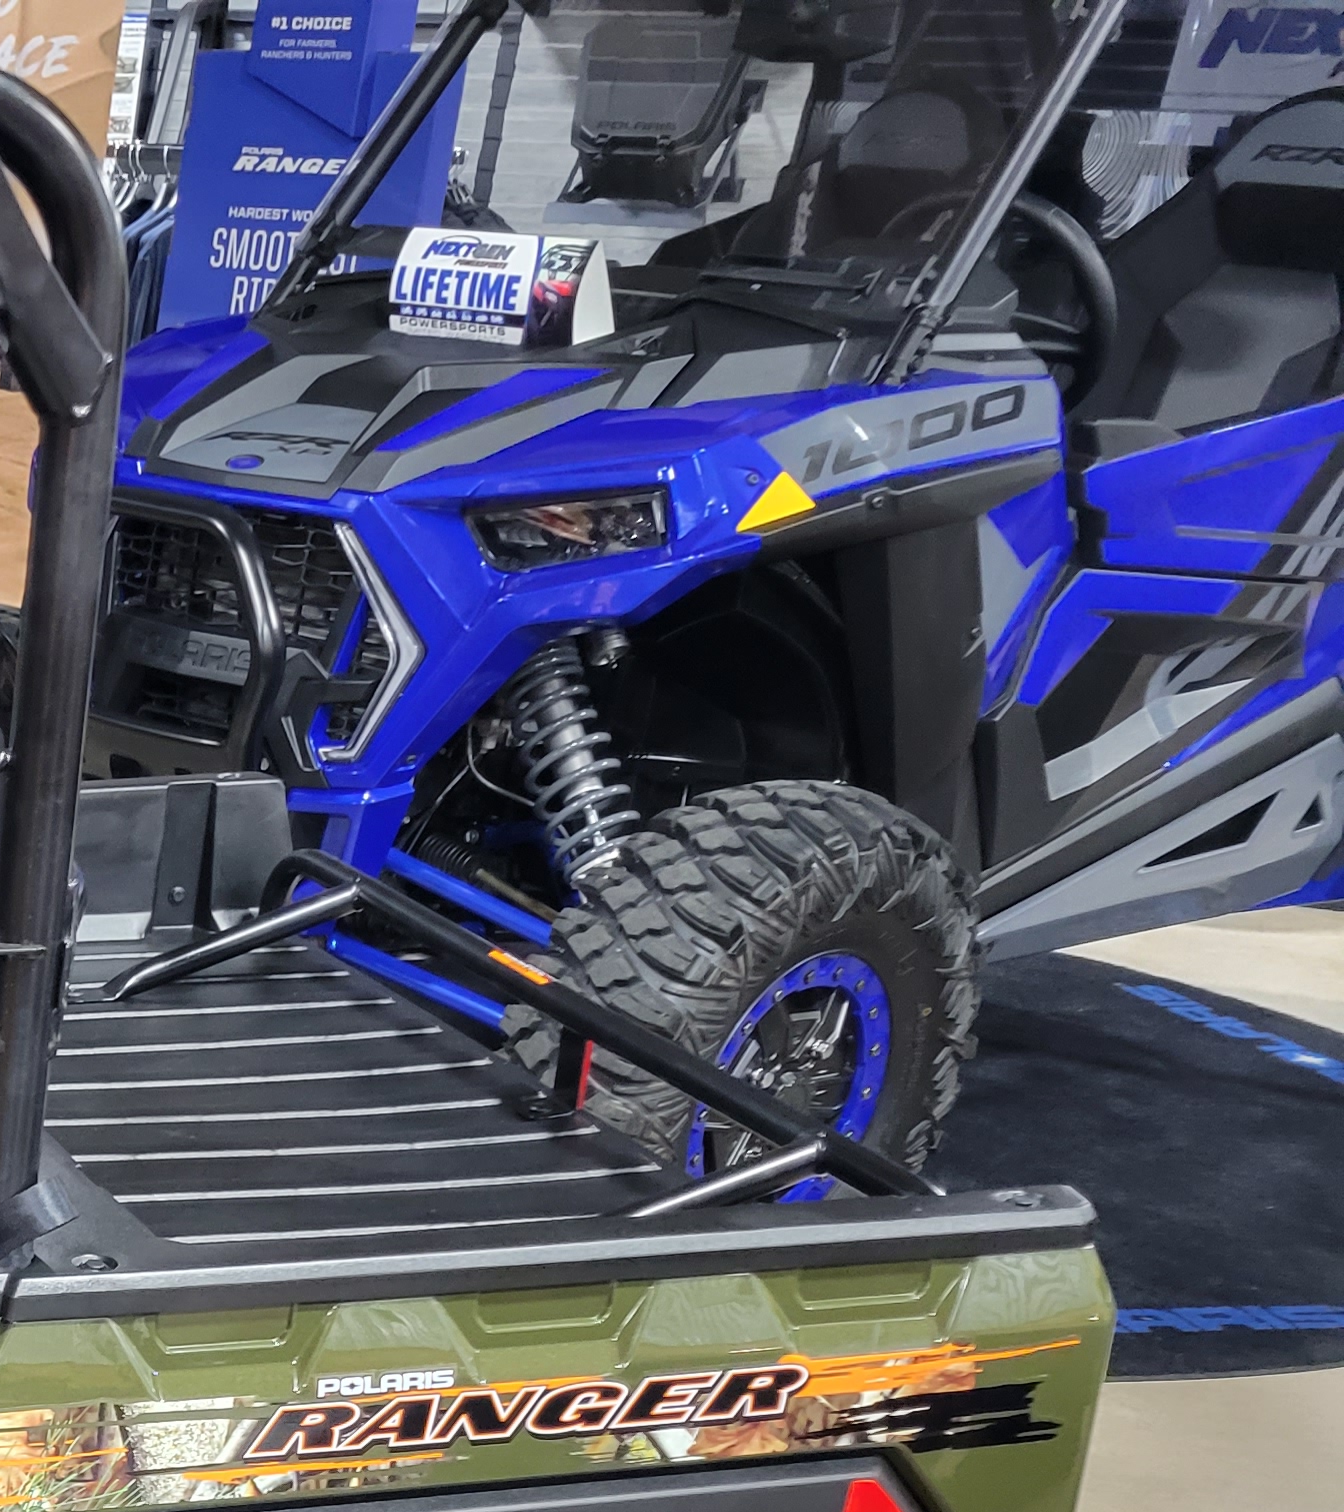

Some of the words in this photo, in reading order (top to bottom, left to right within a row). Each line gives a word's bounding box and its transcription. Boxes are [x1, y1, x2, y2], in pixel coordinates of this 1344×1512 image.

[291, 17, 353, 30] CHOICE
[228, 206, 289, 221] HARDEST
[395, 266, 522, 311] LIFETIME
[400, 317, 506, 336] POWERSPORTS
[1116, 1305, 1344, 1334] ARIS
[317, 1368, 456, 1398] POLARIS
[243, 1362, 811, 1461] RANGER
